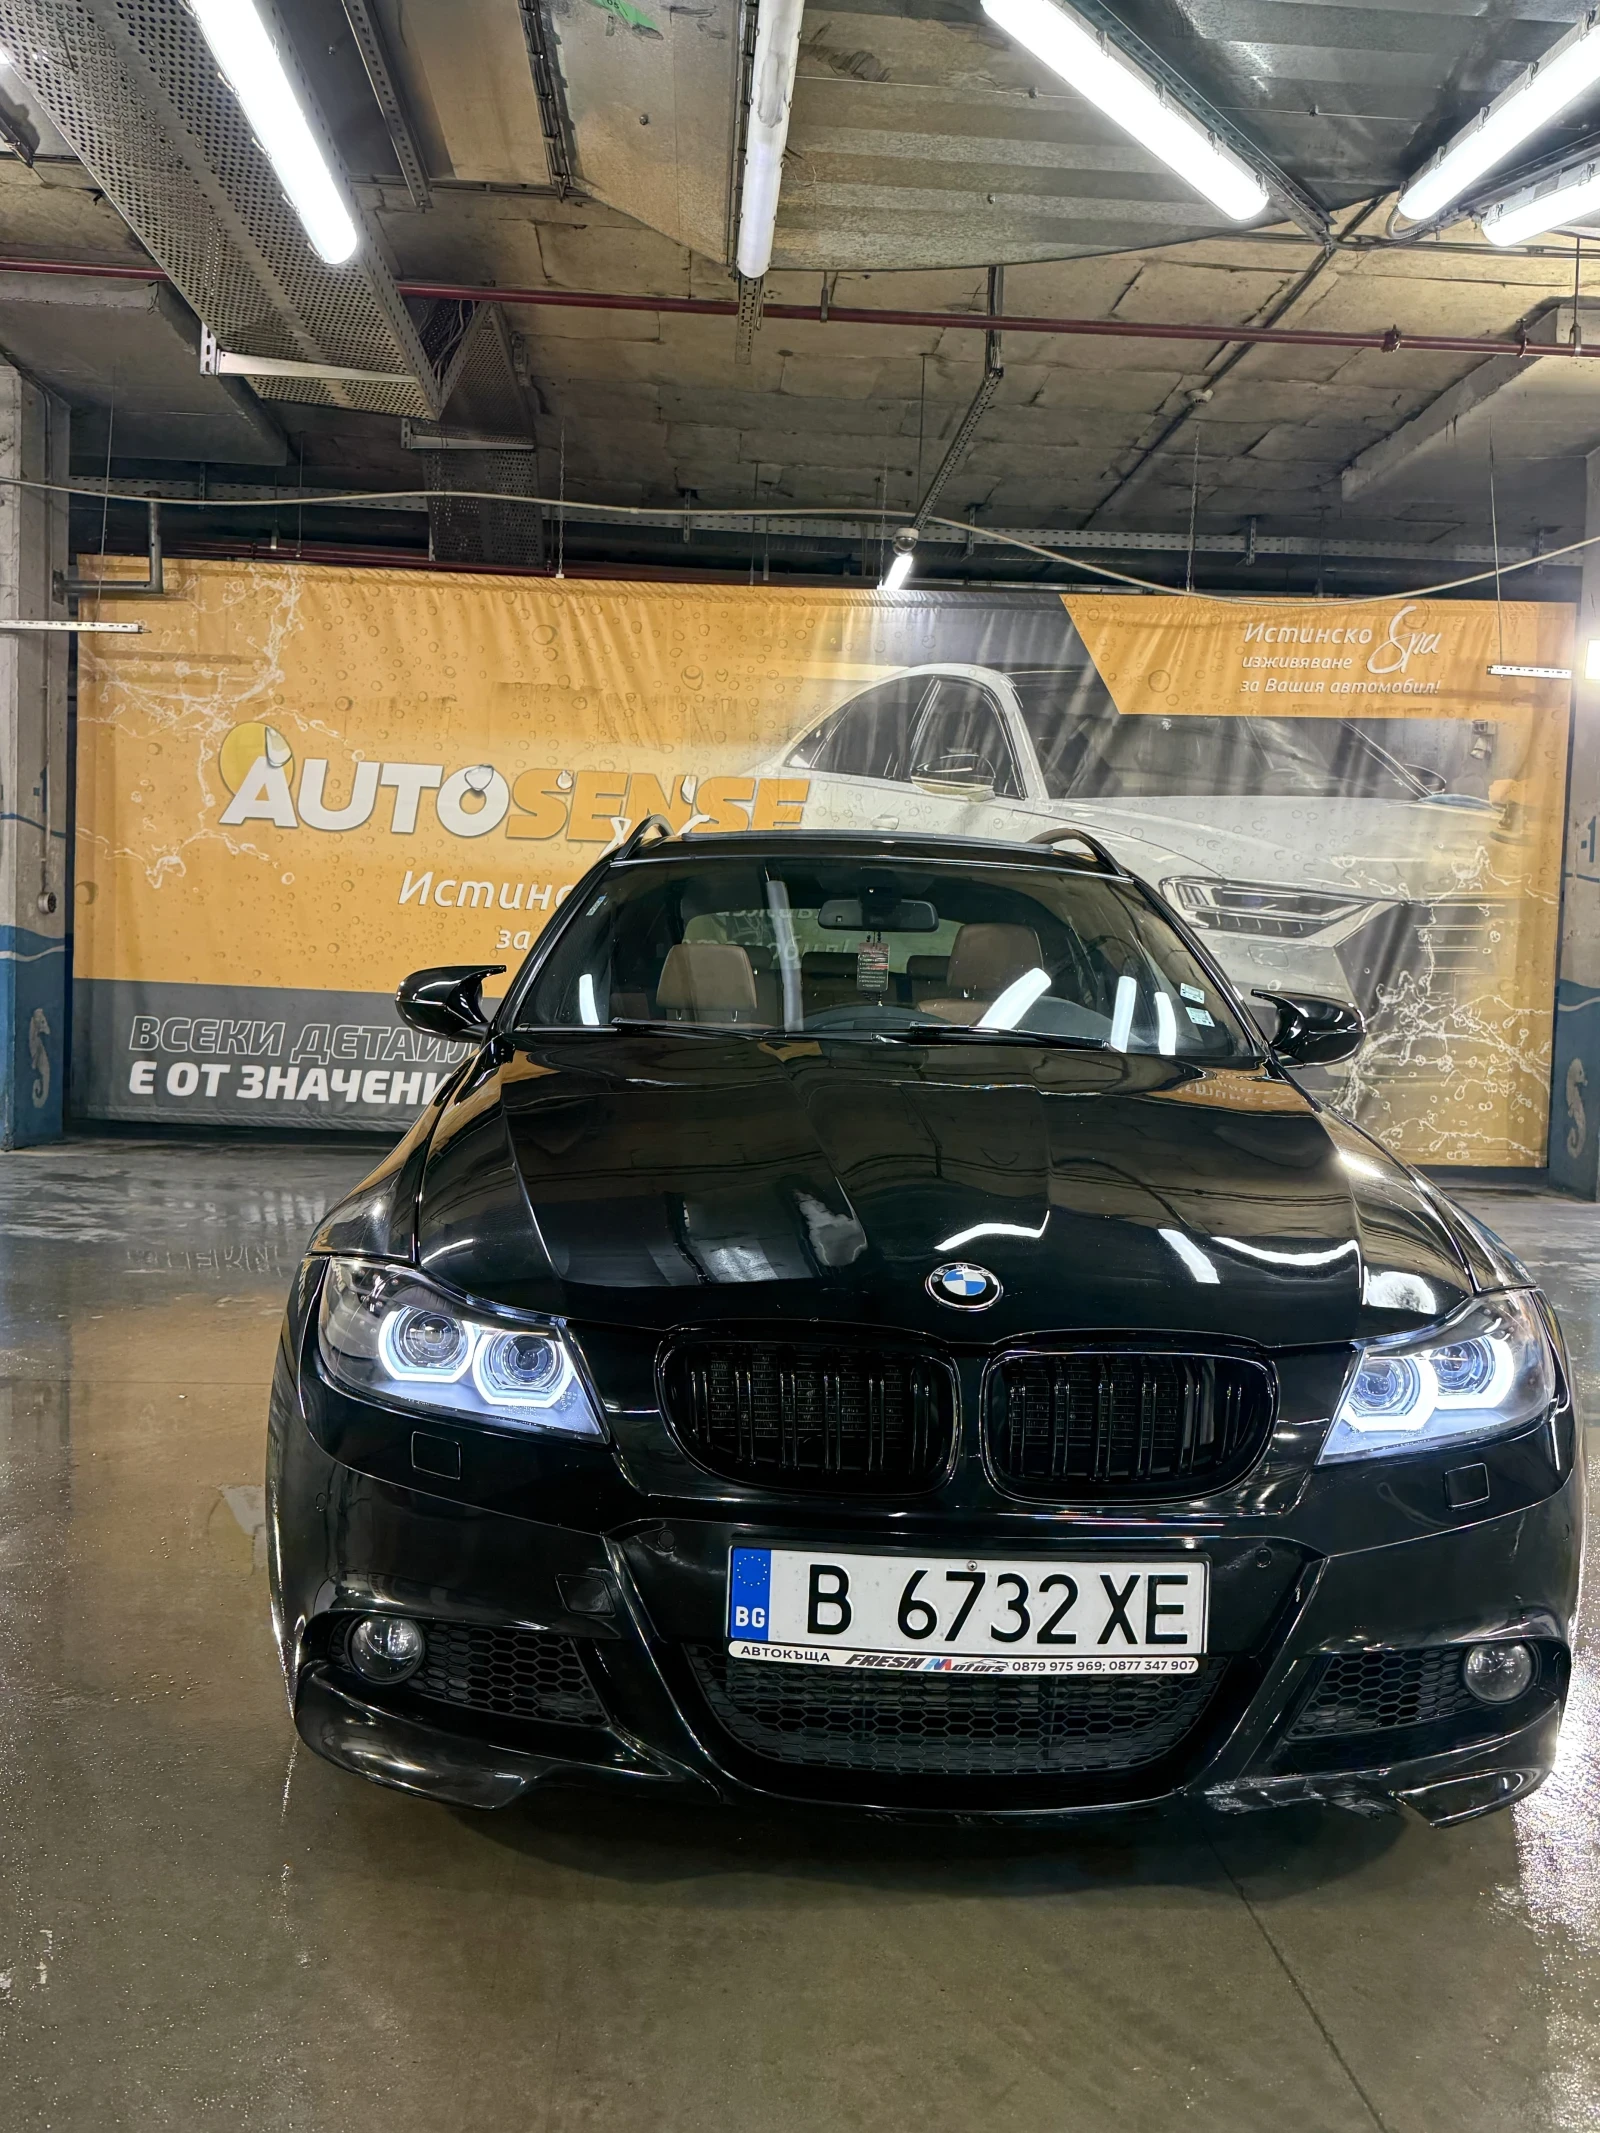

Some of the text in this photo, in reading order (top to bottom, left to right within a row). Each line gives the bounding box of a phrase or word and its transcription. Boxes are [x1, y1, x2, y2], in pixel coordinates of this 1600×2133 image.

[1243, 622, 1373, 645] Истинско
[1366, 605, 1442, 674] Spa
[1242, 655, 1353, 670] изживяване
[1240, 677, 1441, 695] за Вашия автомобил!
[496, 928, 531, 950] за
[129, 1015, 286, 1057] ВСЕКИ
[129, 1060, 158, 1096] Е
[166, 1061, 231, 1098] ОТ
[807, 1563, 1189, 1645] B 6732 XE
[735, 1605, 766, 1629] BG
[740, 1645, 831, 1663] АВТОКЪЩА
[845, 1653, 926, 1670] FRESH
[1012, 1660, 1195, 1673] 0879 975 969; 0877 347 907
